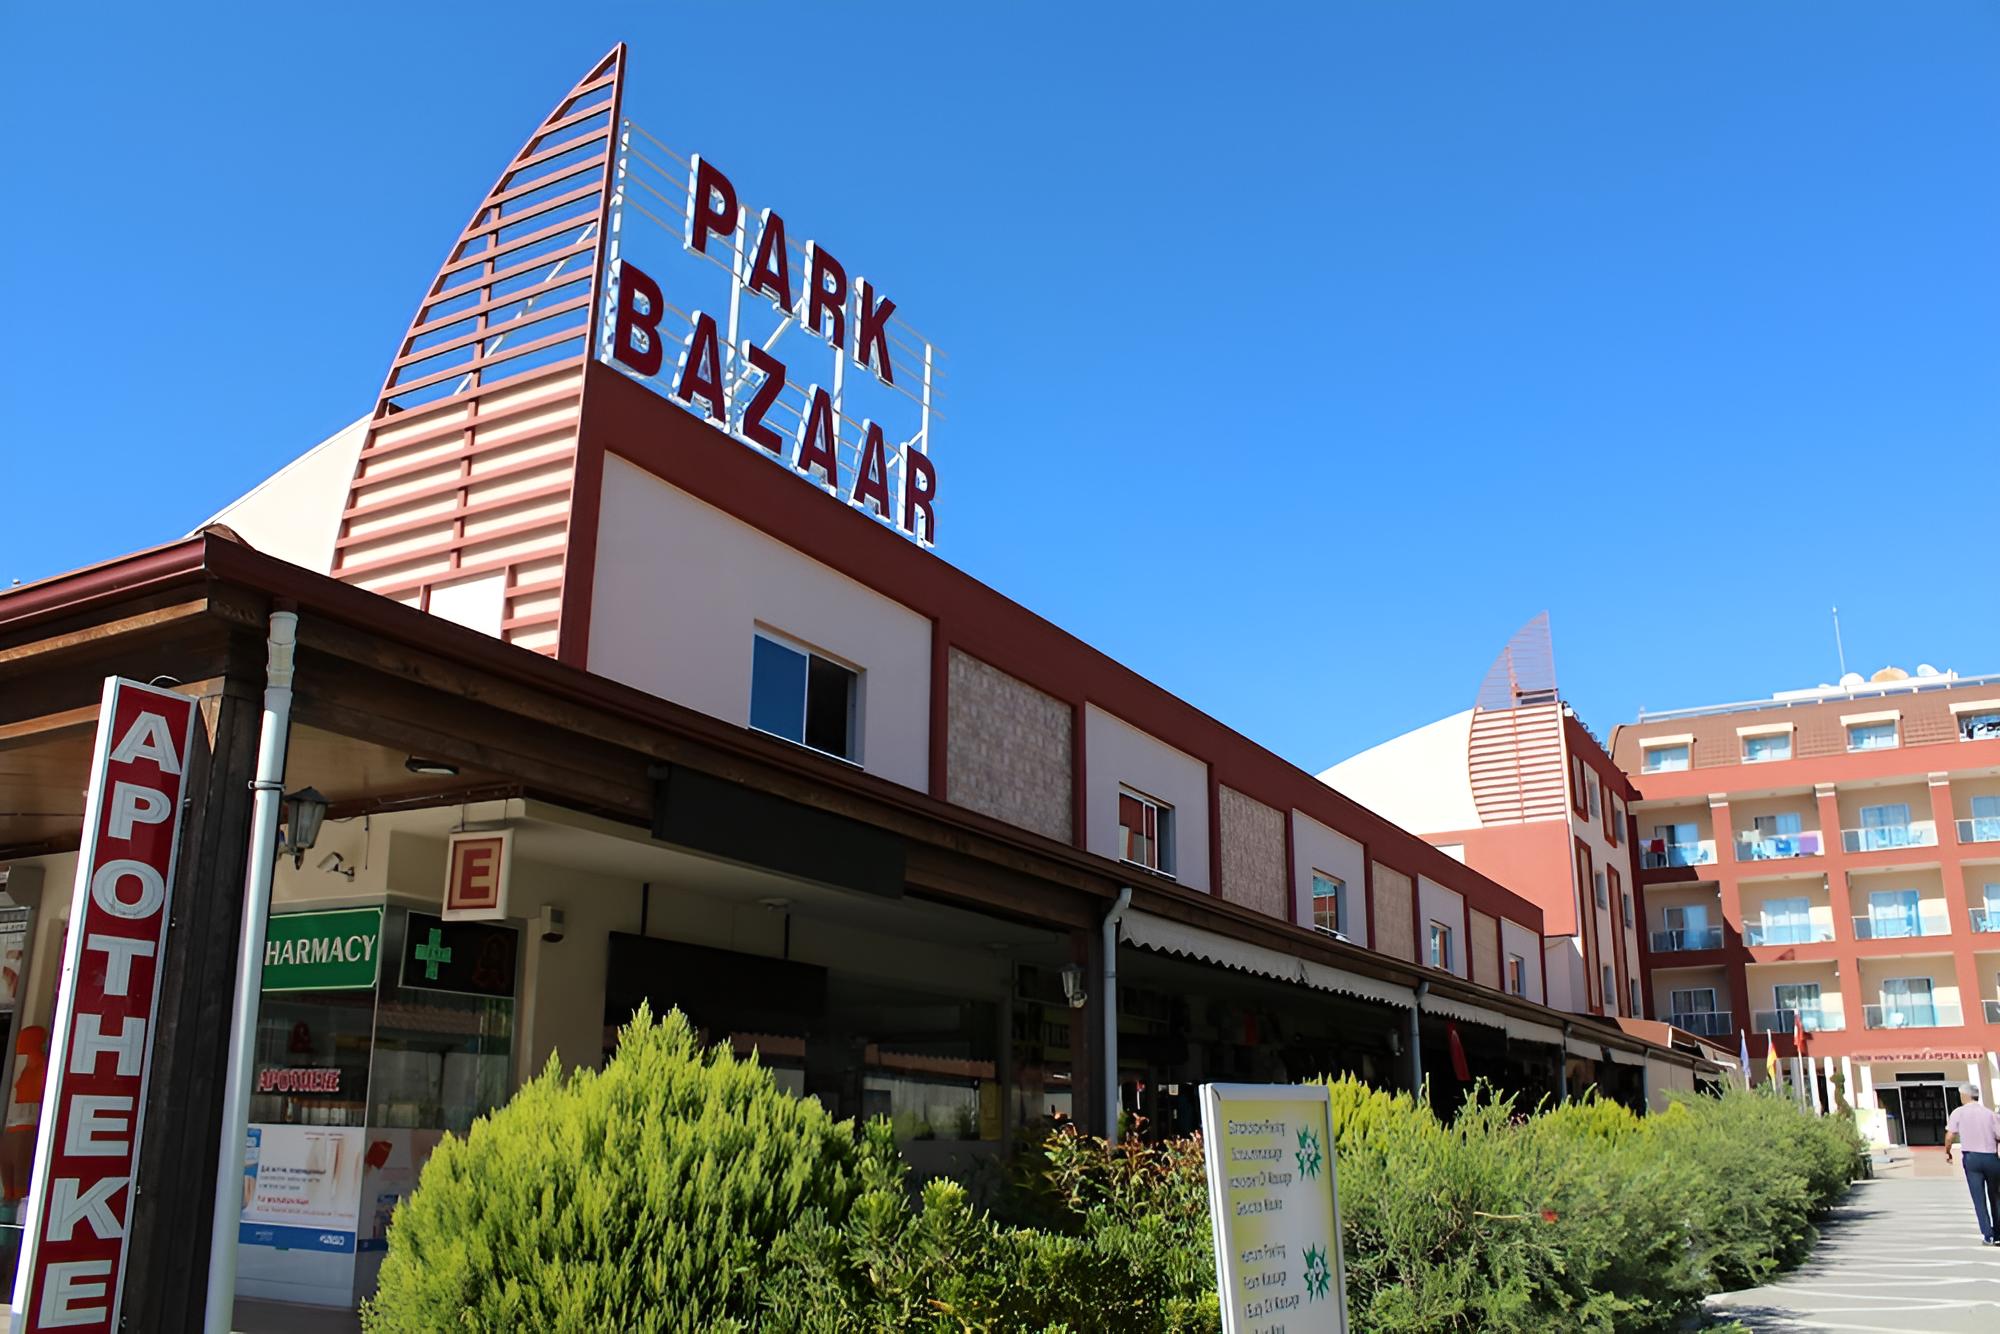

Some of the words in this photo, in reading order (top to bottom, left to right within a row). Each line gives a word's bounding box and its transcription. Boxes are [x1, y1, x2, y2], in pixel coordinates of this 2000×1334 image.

[684, 153, 896, 387] PARK
[600, 258, 937, 548] BAZAAR
[264, 934, 376, 966] HARMACY
[459, 848, 492, 899] E
[37, 710, 182, 1329] APOTHEKE
